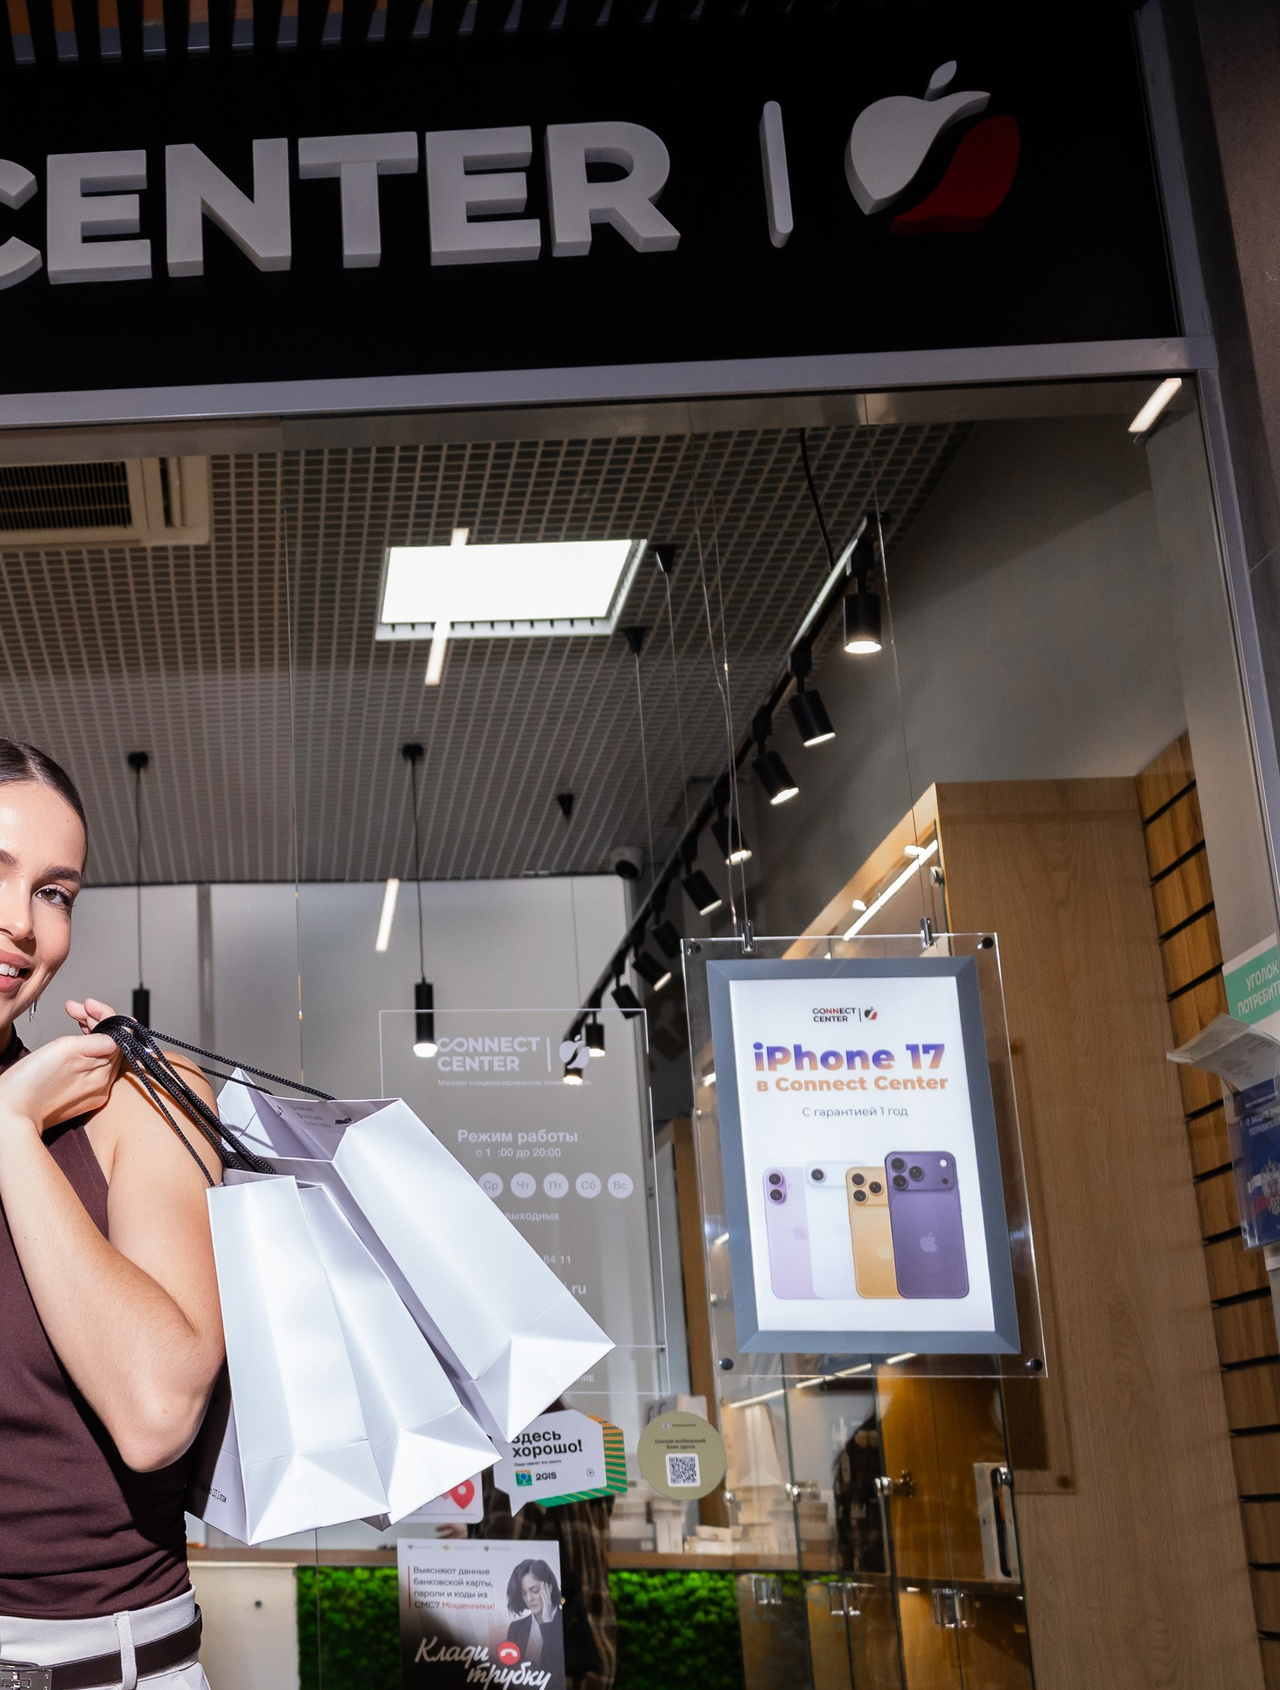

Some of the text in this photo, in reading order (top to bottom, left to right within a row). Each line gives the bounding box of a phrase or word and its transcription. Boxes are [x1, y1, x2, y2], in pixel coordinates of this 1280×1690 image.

[1246, 961, 1279, 992] УГОЛОК
[812, 1007, 856, 1015] CONNECT
[813, 1015, 849, 1023] CENTER
[437, 1037, 540, 1053] CONNECT
[753, 1042, 946, 1072] iPhone 17
[437, 1056, 520, 1072] CENTER
[756, 1075, 949, 1092] в Connect Center
[802, 1106, 909, 1119] С гарантией 1 год
[457, 1129, 578, 1146] Режим работы
[516, 1150, 530, 1159] до
[532, 1148, 562, 1158] 20:00
[484, 1180, 628, 1192] Ср Чт Пт Сб Вс
[560, 1255, 571, 1264] 11
[512, 1439, 583, 1459] хорошо!
[535, 1472, 557, 1482] 2GIS
[413, 1566, 491, 1577] Выясняют данные
[413, 1578, 494, 1589] банковской карты,
[414, 1591, 445, 1600] пароли
[454, 1592, 476, 1600] коды
[414, 1602, 495, 1611] СМС? Мошенники!
[414, 1636, 489, 1669] Клади
[466, 1661, 552, 1690] трубку
